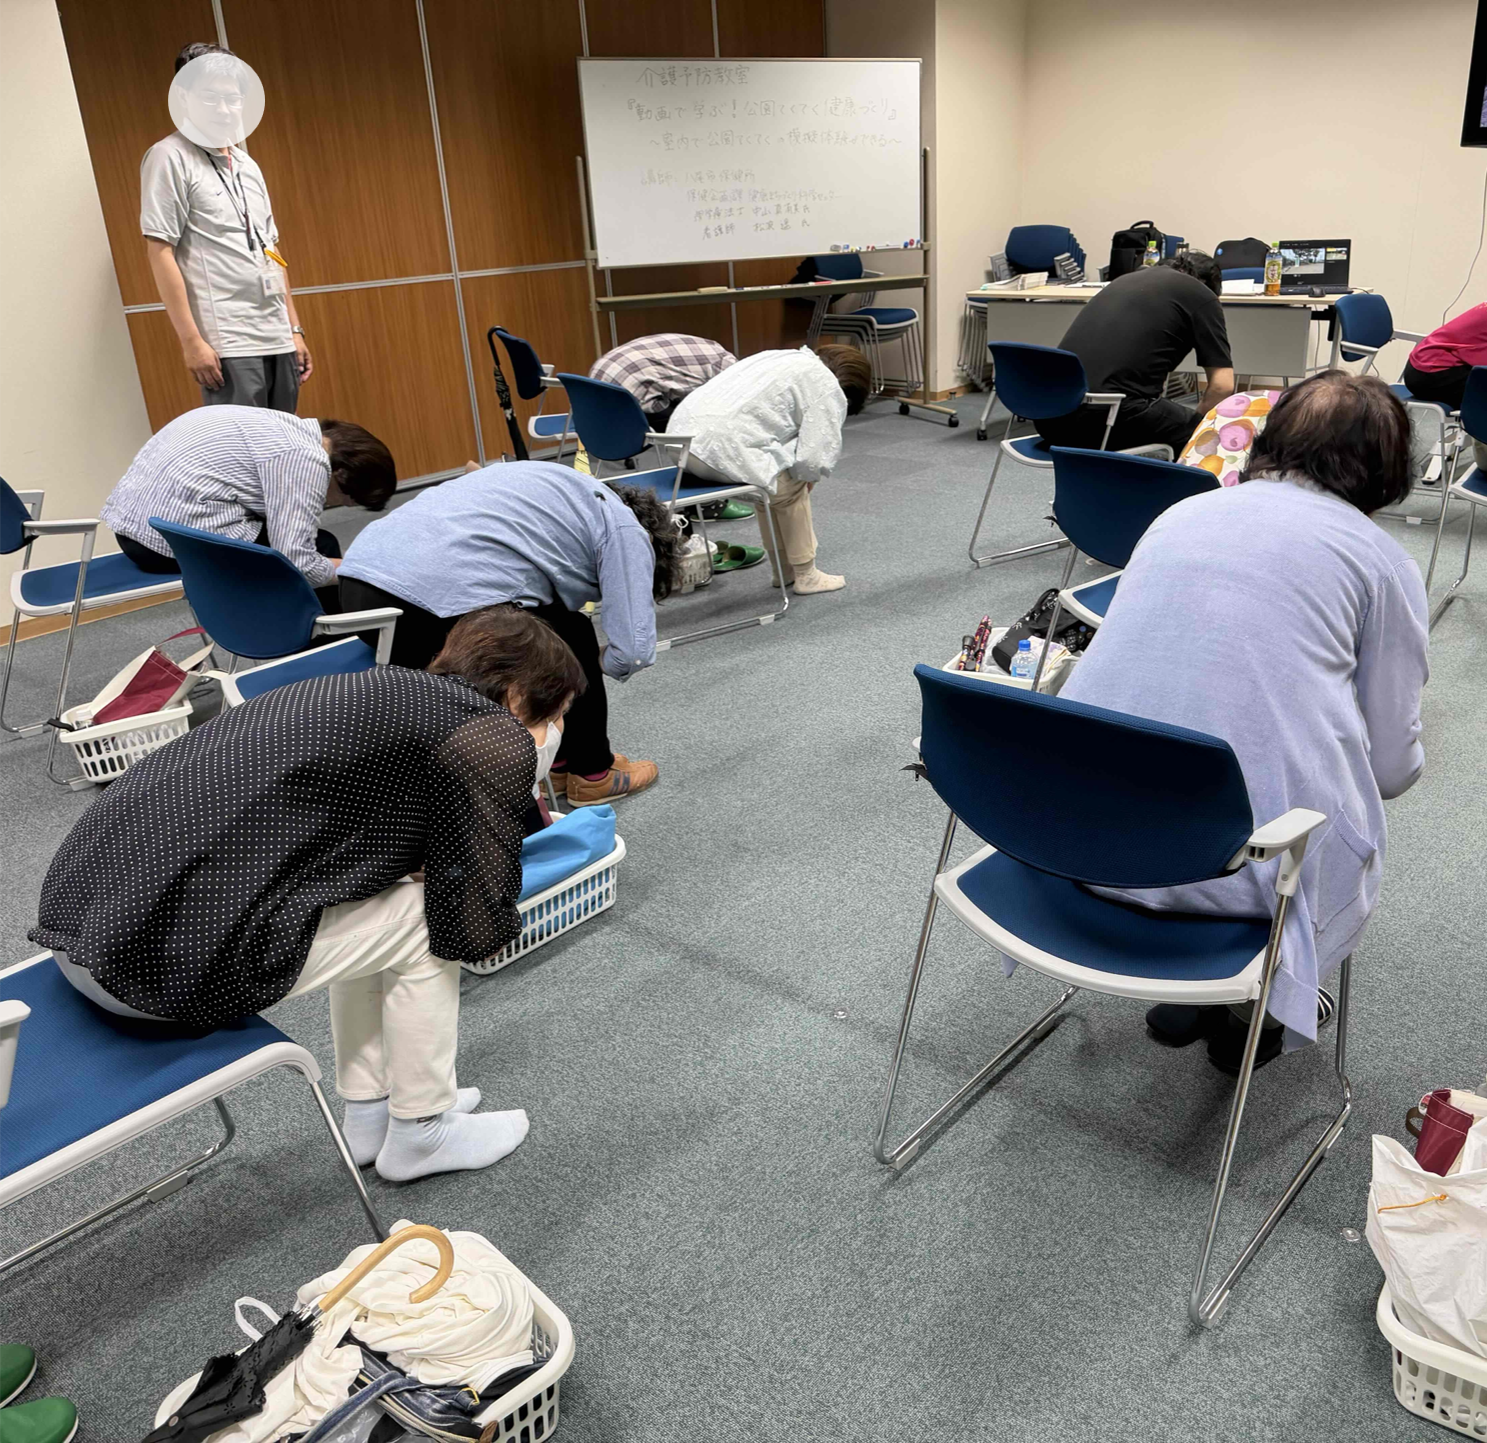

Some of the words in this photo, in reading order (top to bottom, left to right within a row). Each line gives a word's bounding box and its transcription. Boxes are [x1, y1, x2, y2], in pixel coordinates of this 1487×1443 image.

[636, 66, 751, 88] 介護予防教室
